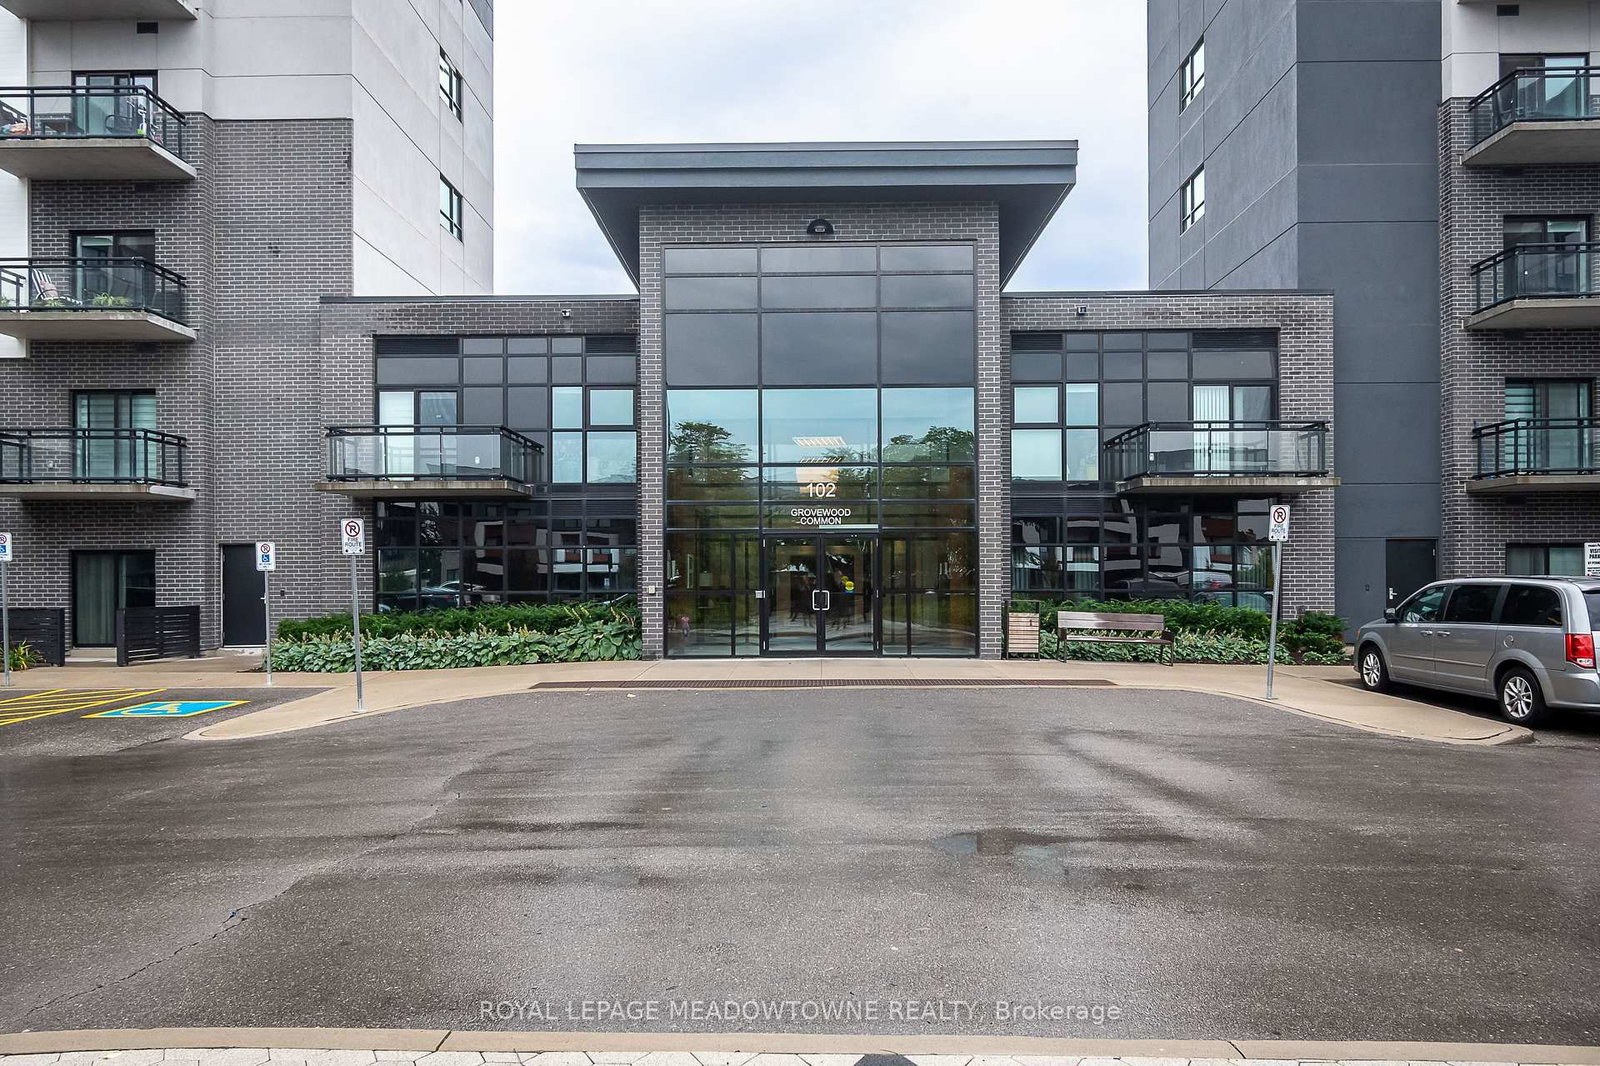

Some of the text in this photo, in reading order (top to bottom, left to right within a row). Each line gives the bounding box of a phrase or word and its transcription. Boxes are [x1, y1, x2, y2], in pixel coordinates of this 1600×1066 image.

[806, 482, 836, 498] 102
[790, 508, 852, 517] GROVEWOOD
[800, 516, 842, 525] COMMON
